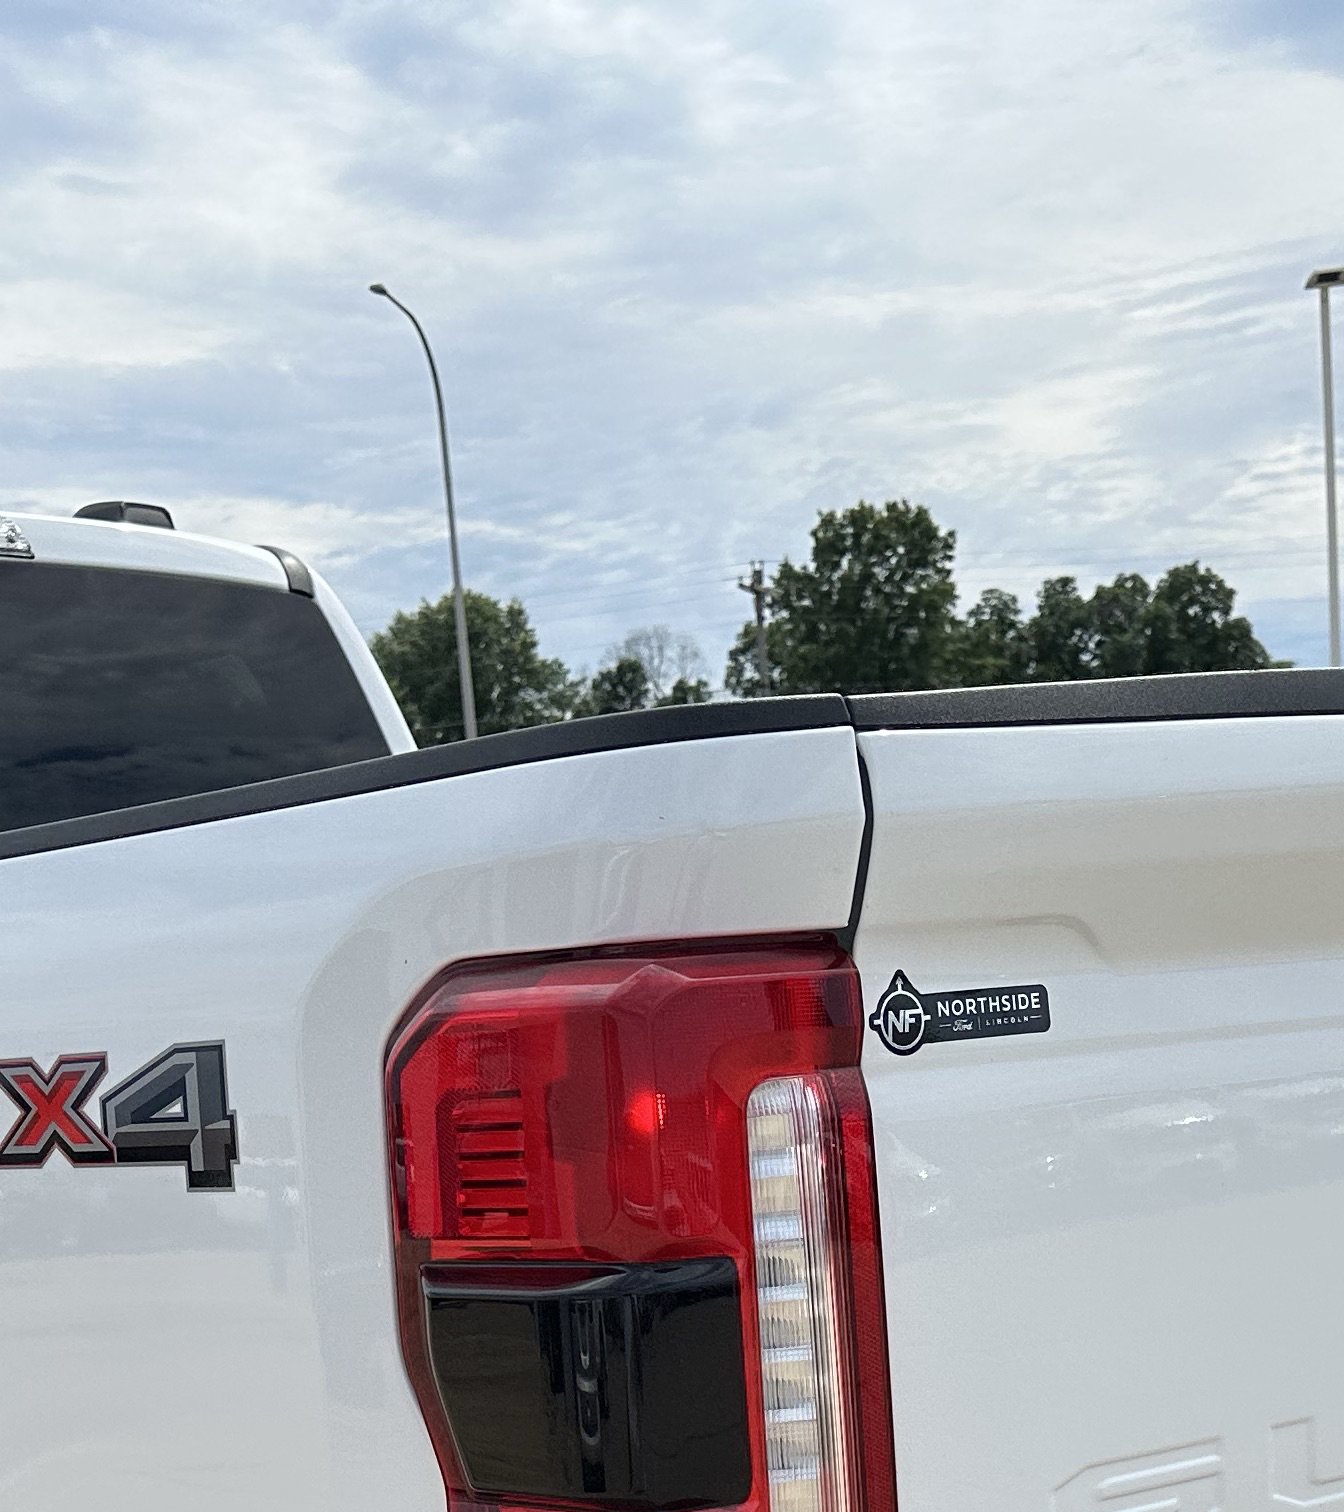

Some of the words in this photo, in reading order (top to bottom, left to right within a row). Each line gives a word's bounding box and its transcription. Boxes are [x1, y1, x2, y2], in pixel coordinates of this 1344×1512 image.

[937, 993, 1041, 1017] NORTHSIDE
[887, 1008, 923, 1042] NF
[952, 1019, 974, 1032] Ford
[985, 1015, 1030, 1026] LINCOLN
